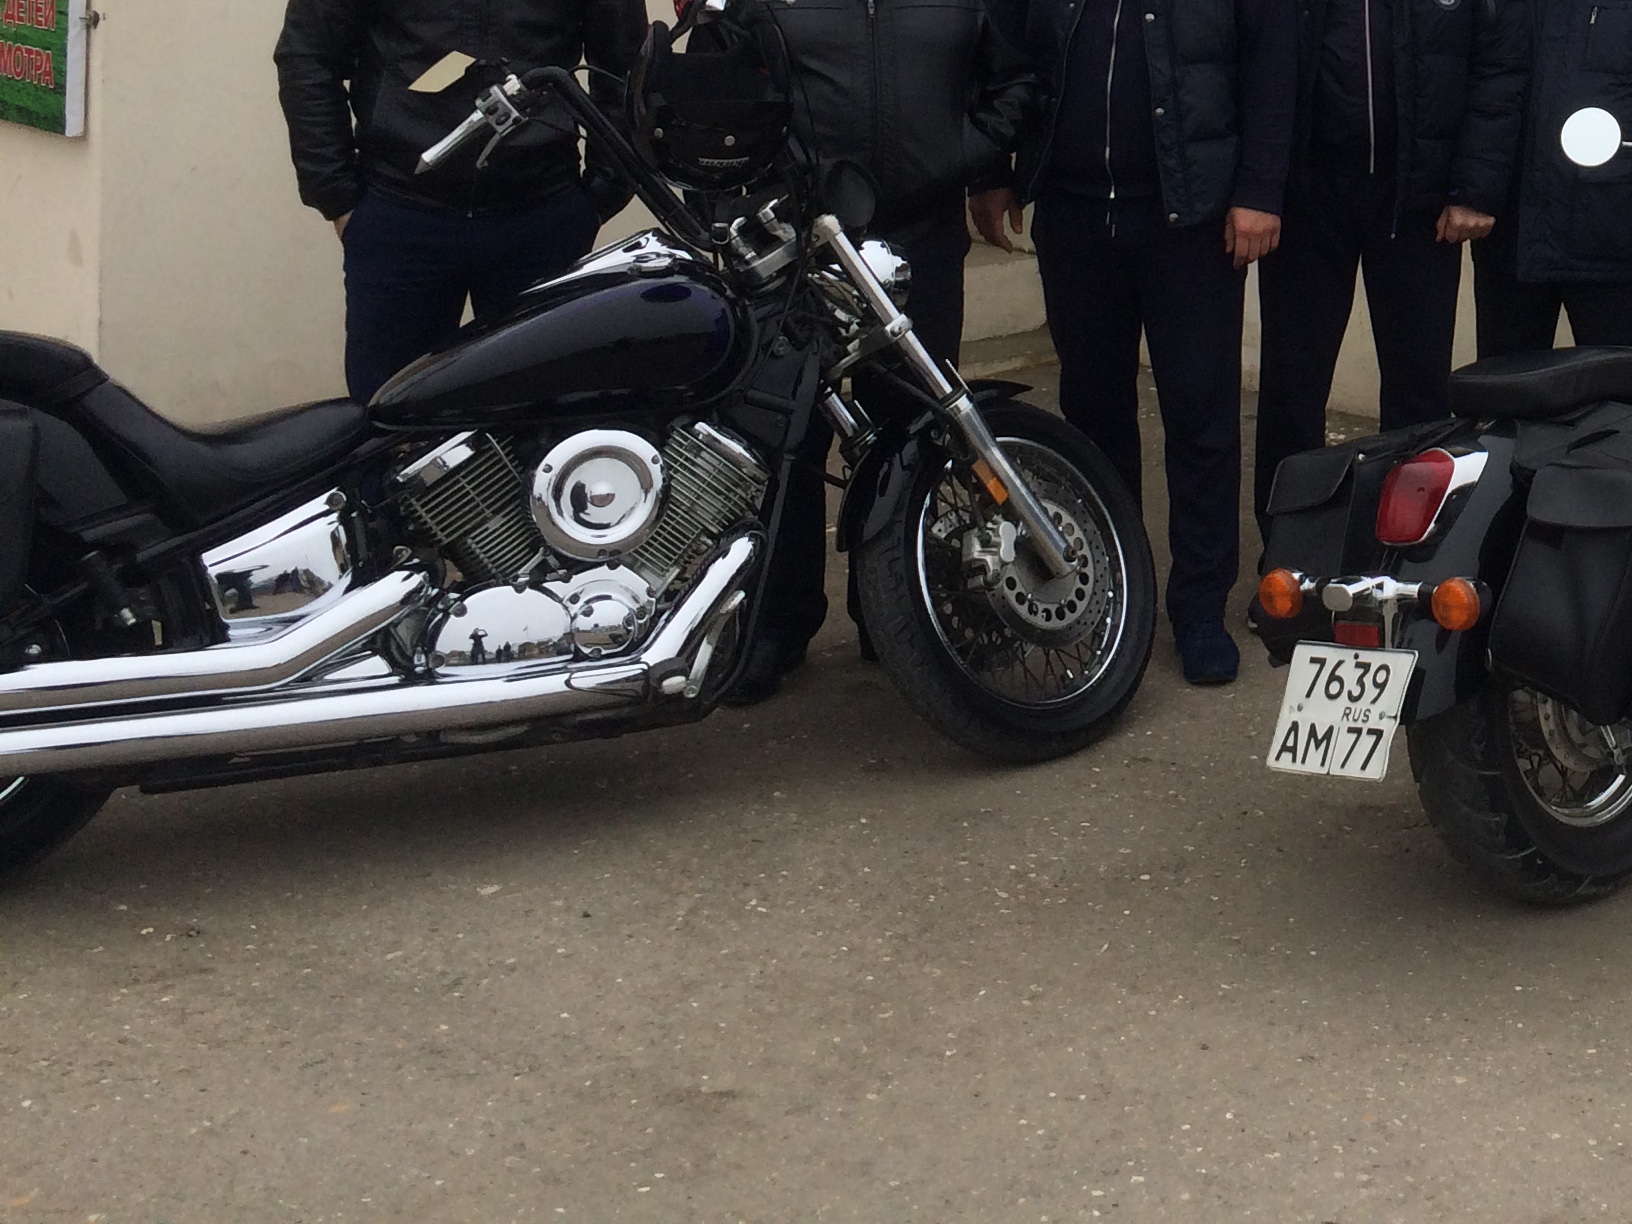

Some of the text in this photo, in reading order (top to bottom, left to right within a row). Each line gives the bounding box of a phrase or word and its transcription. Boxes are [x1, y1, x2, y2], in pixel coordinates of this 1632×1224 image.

[1305, 656, 1391, 705] 7639
[1341, 706, 1371, 723] RUS
[1340, 727, 1385, 771] 77
